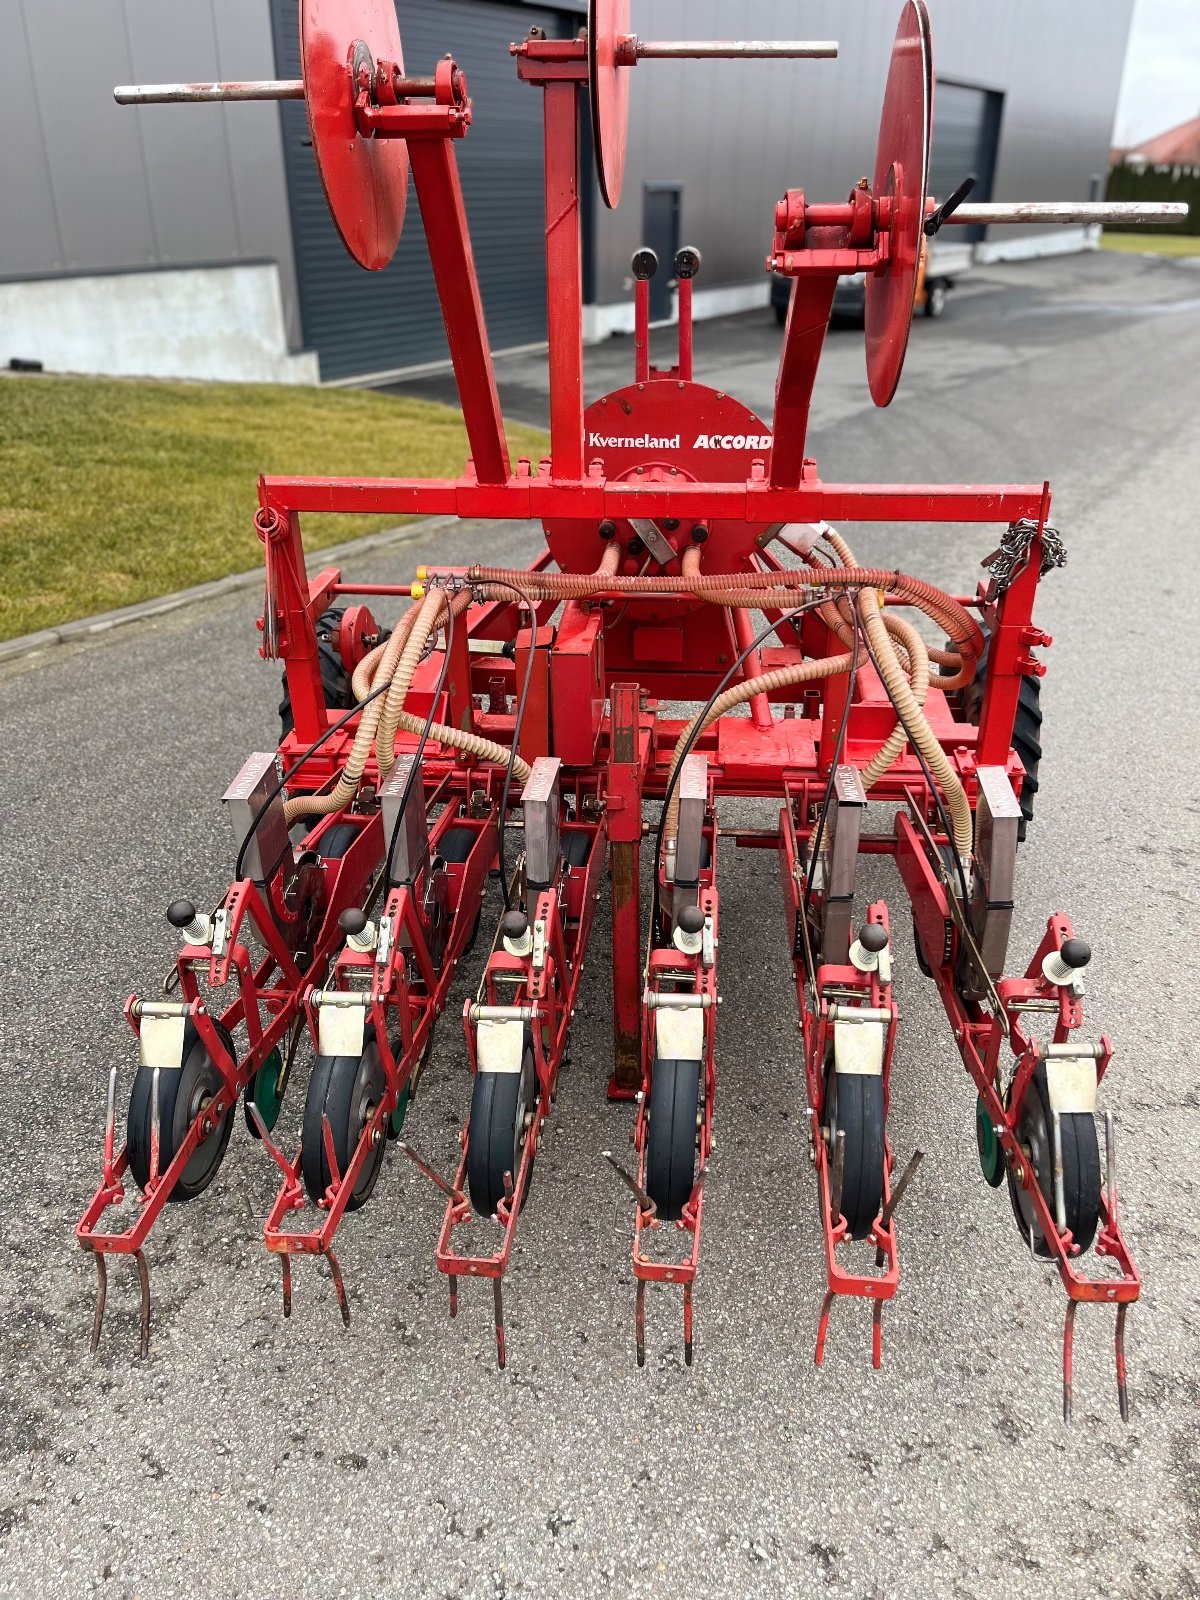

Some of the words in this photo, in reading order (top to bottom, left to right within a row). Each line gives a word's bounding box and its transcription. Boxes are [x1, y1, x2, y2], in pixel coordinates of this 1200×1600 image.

[589, 433, 680, 449] Kverneland
[693, 434, 773, 450] ACCORD
[230, 763, 263, 798] MINIAIR
[385, 762, 413, 796] MINIAIR
[839, 772, 861, 801] MINIAIR
